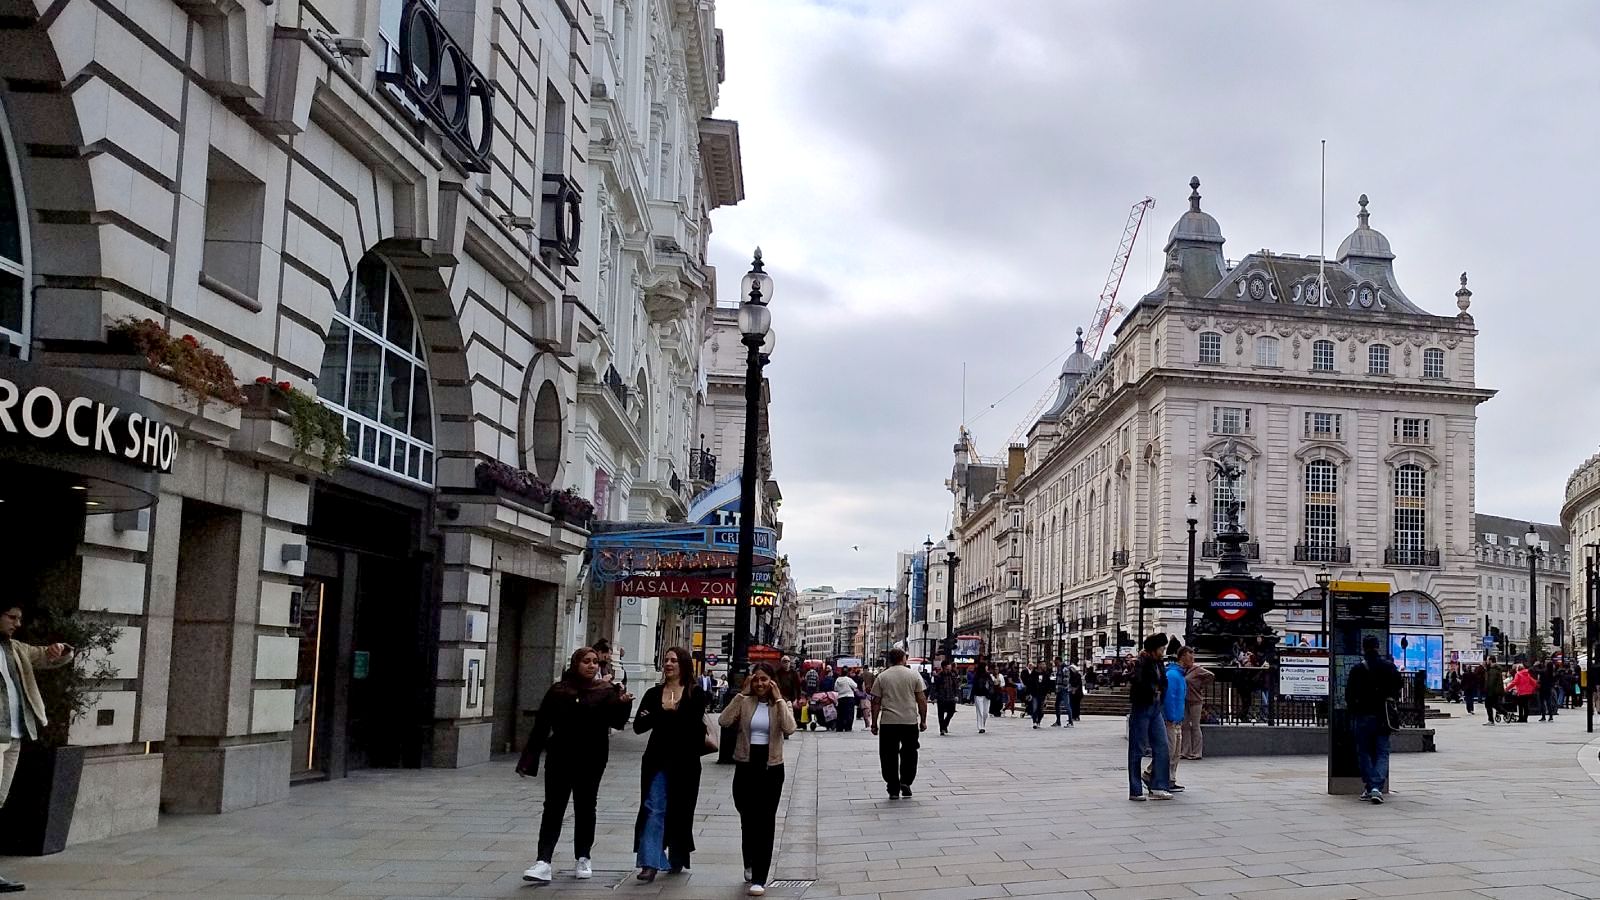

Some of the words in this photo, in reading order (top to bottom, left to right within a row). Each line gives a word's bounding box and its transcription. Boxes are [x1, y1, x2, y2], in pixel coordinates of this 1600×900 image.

[0, 378, 120, 454] ROCK
[124, 412, 179, 474] SHOP
[621, 580, 690, 594] MASALA
[700, 581, 736, 595] ZON
